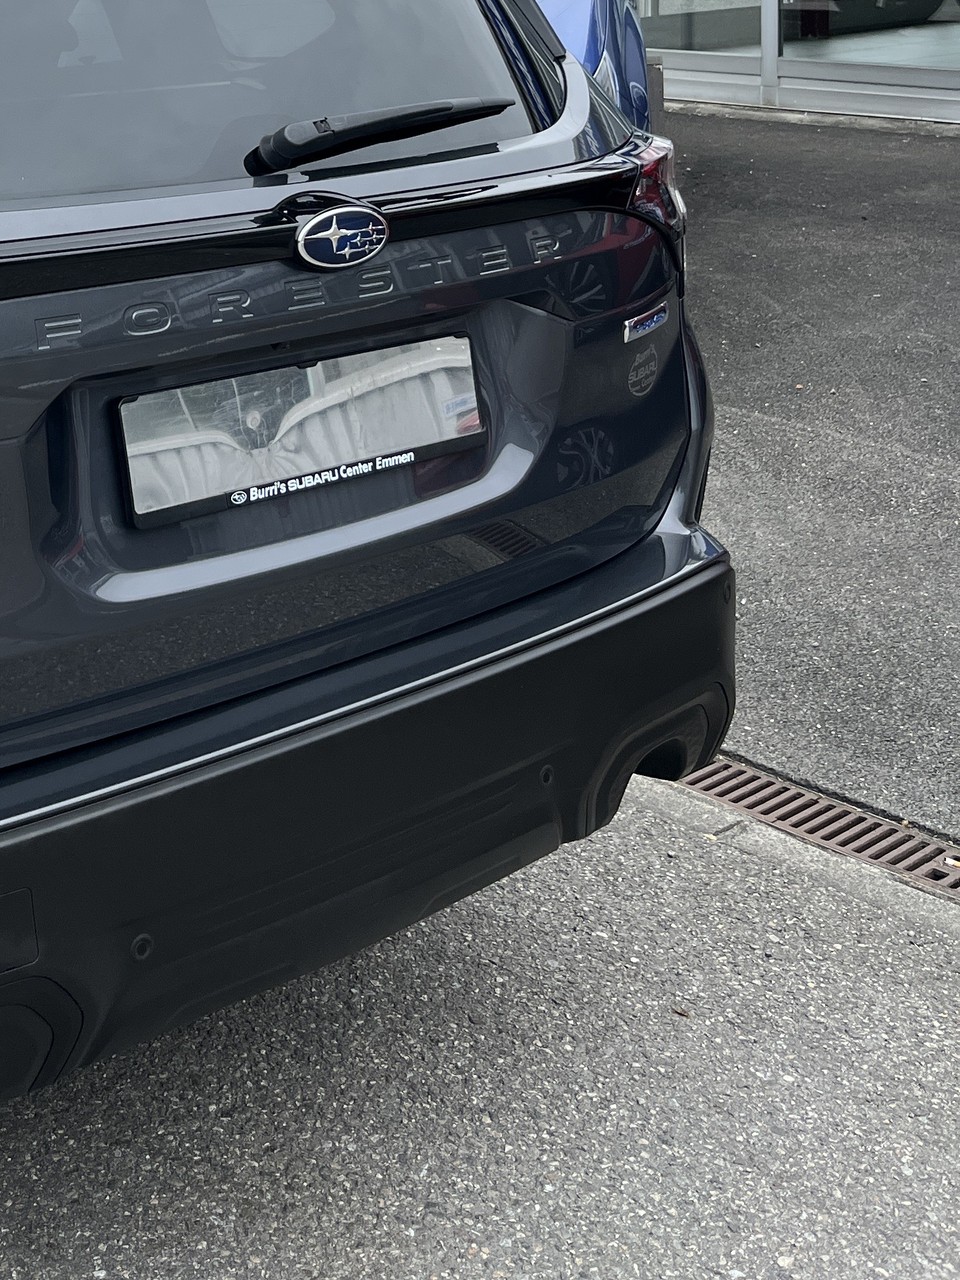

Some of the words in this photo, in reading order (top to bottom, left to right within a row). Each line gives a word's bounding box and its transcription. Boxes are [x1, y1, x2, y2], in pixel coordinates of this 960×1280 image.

[35, 236, 563, 350] FORESTER
[249, 481, 286, 501] Burri's
[287, 469, 339, 492] SUBARU
[340, 461, 373, 478] Center
[375, 451, 414, 470] Emmen
